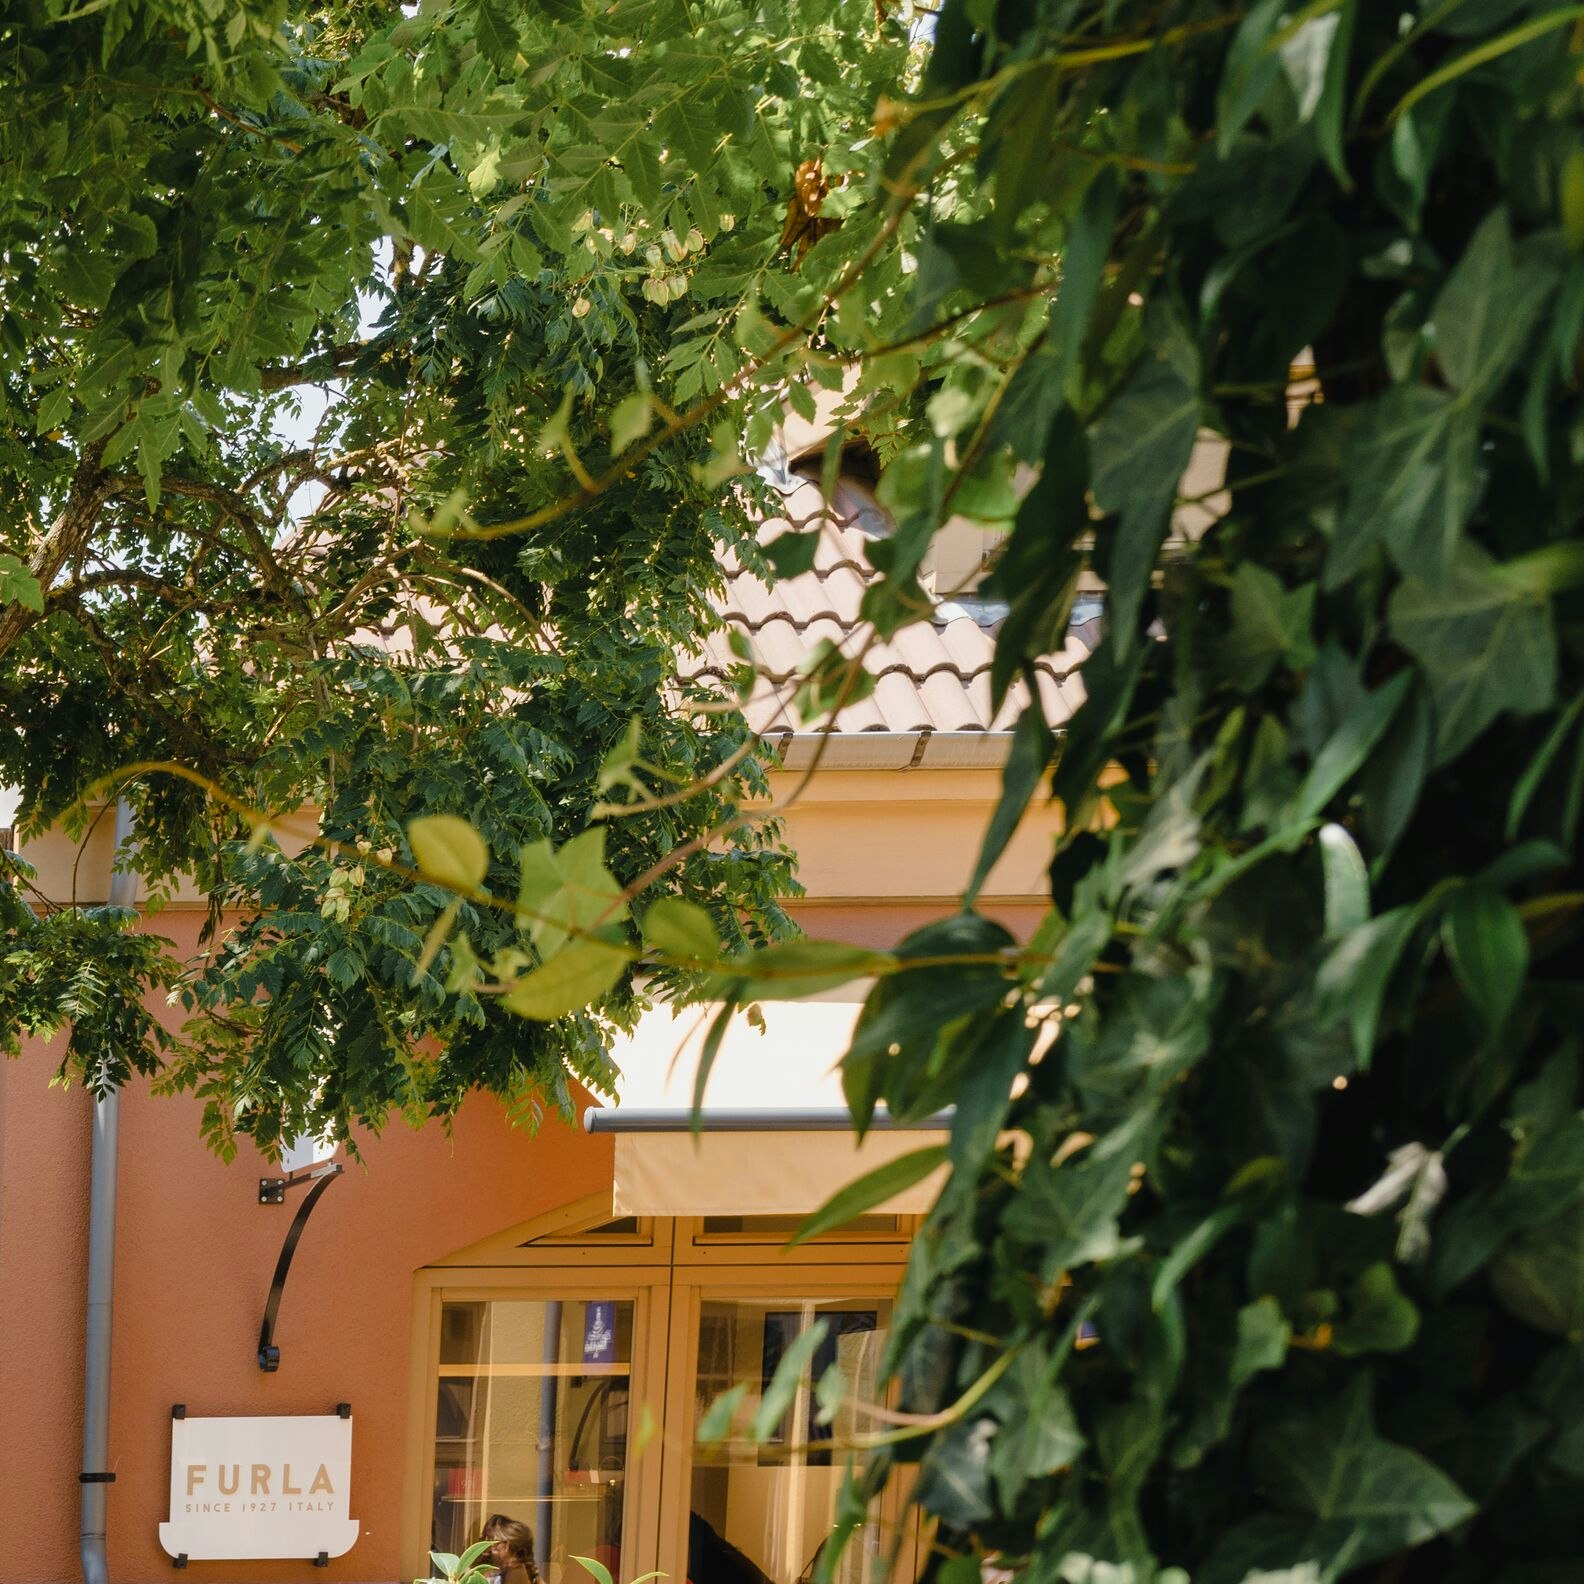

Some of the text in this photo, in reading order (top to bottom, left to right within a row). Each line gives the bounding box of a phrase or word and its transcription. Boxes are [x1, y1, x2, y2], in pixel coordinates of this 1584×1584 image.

[186, 1463, 334, 1496] FURLA
[185, 1501, 334, 1513] SINCE 1927 ITALY
